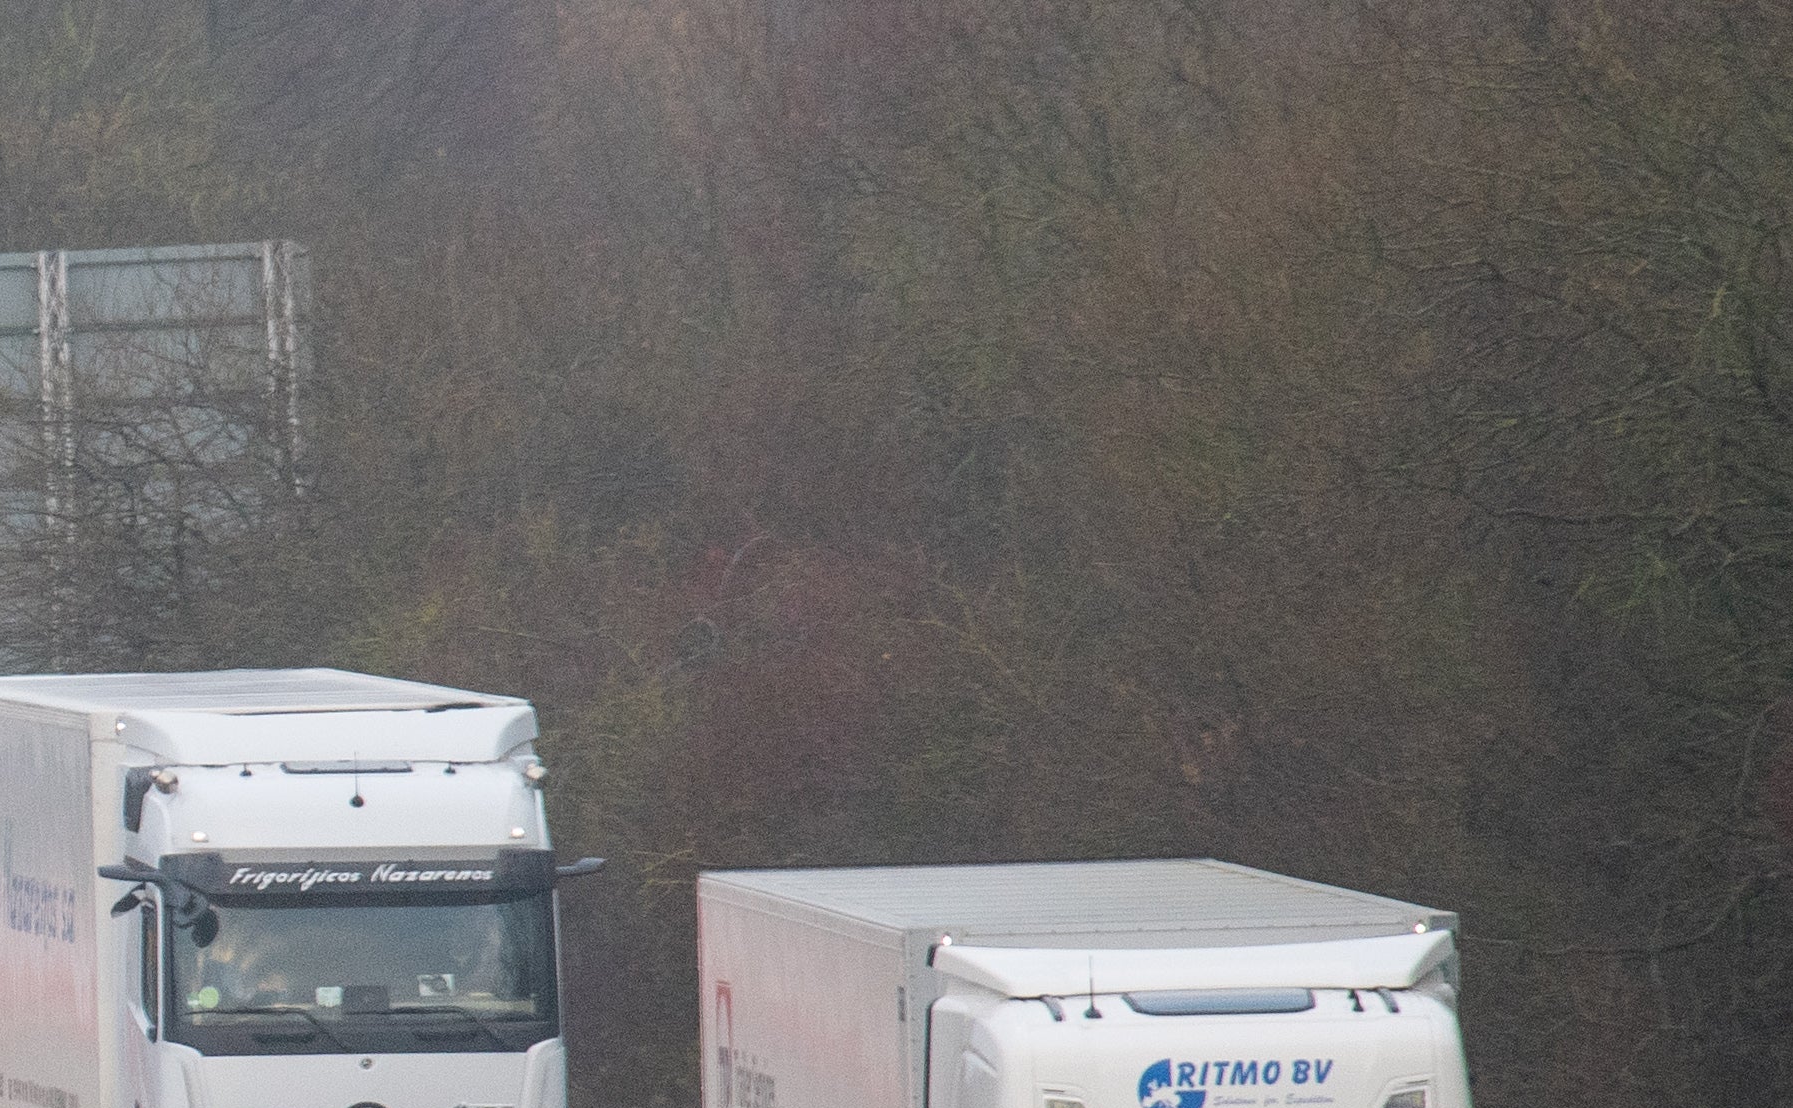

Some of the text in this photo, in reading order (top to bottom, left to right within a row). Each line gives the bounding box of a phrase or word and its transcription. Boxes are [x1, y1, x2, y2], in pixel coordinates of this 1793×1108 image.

[370, 863, 494, 883] Nazarenos
[1176, 1058, 1333, 1087] RITMO BV
